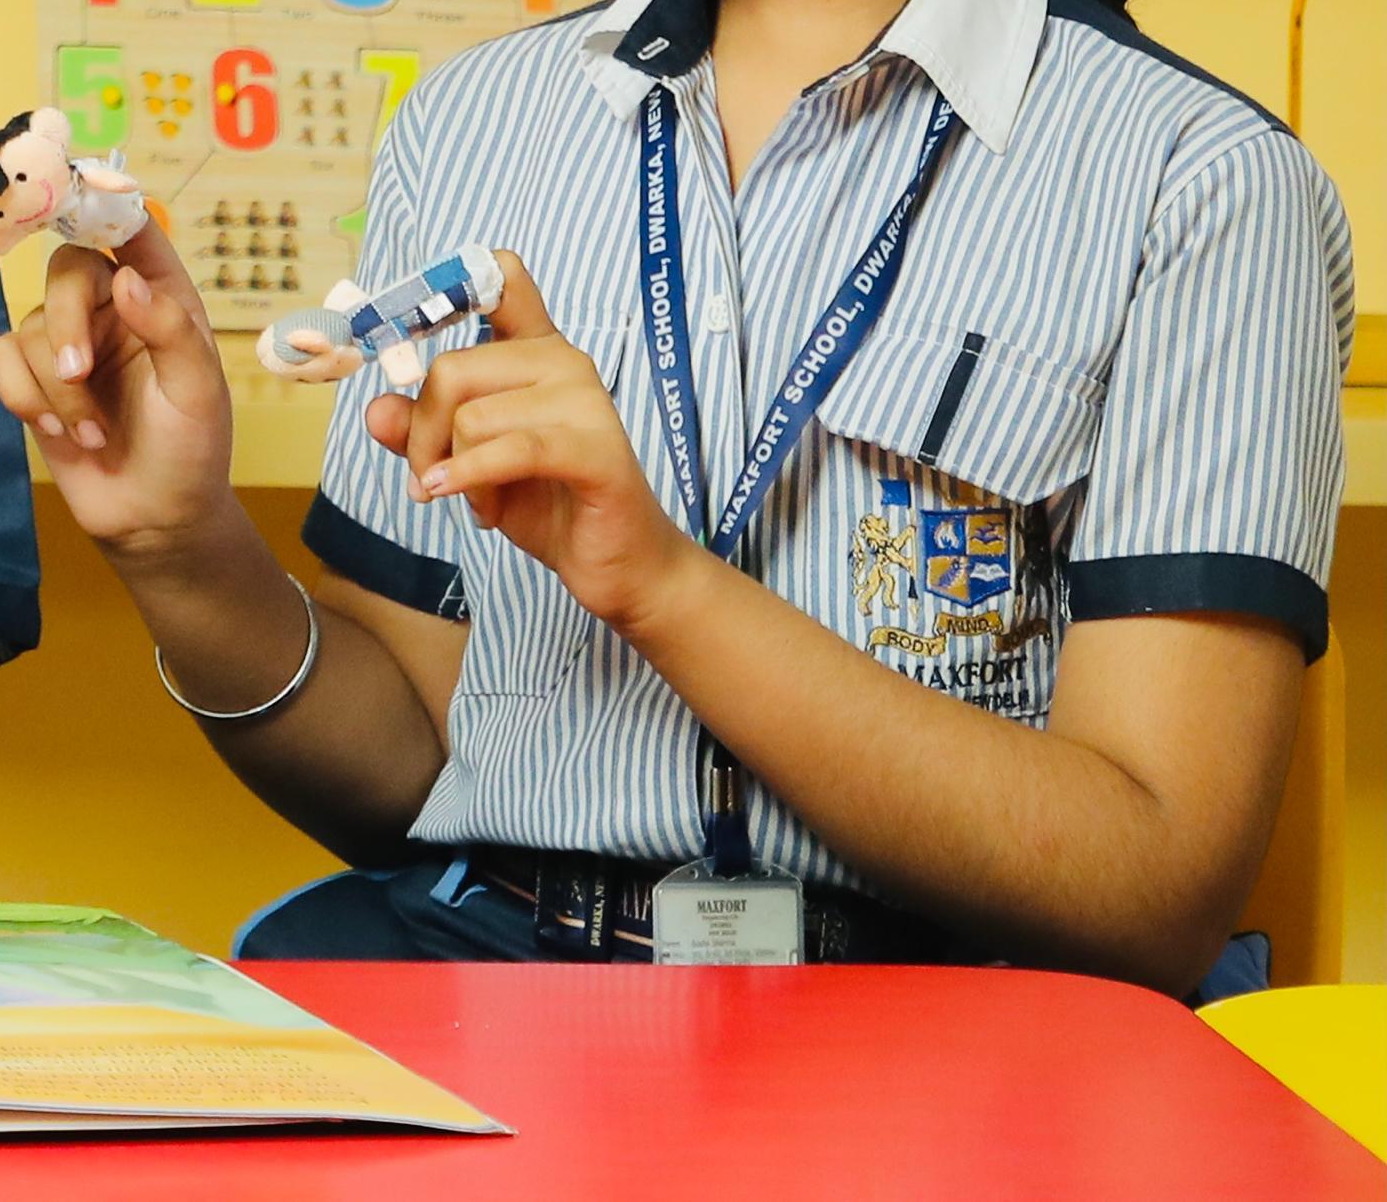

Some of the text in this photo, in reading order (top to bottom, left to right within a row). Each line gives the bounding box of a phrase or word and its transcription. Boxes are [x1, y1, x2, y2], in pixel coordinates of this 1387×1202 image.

[58, 45, 420, 151] 5 6 7
[648, 144, 667, 255] DWARKA,
[650, 257, 676, 371] SCHOOL,
[720, 192, 917, 535] MAXFORT SCHOOL, DWARKA,
[662, 378, 697, 507] MAXFORT
[887, 631, 937, 657] BODY
[947, 617, 990, 634] MIND
[697, 899, 747, 913] MAXFORT
